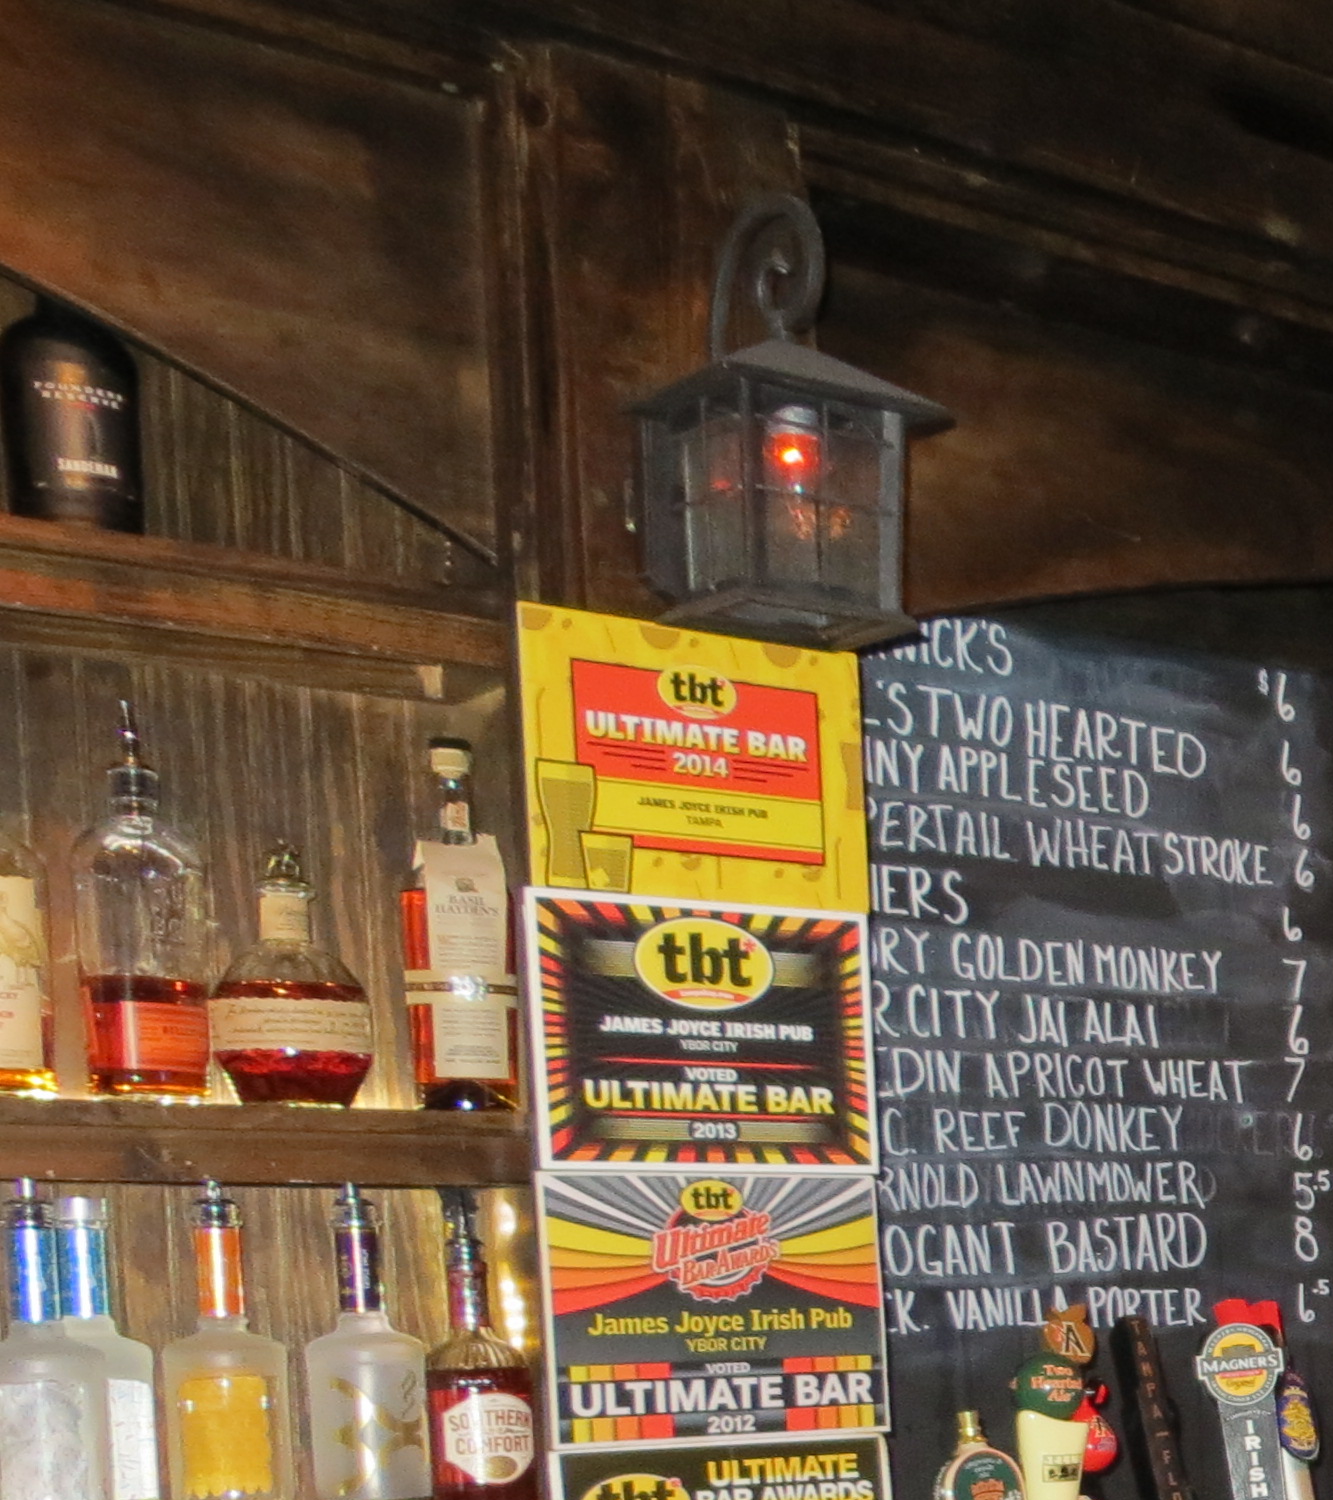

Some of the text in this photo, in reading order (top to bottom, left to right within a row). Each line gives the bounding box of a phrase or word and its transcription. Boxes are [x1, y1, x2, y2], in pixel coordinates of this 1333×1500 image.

[671, 672, 725, 707] tbt
[585, 710, 807, 762] ULTIMATE BAR
[917, 685, 1013, 747] TWO
[1025, 700, 1206, 778] HEARTED
[673, 752, 730, 778] 2014
[938, 743, 1149, 818] APPLESEED
[638, 797, 675, 810] JAMES
[678, 800, 713, 814] JOYCE
[748, 807, 768, 819] PUB
[1025, 817, 1158, 875] WHEAT
[1162, 832, 1274, 885] STROKE
[657, 933, 752, 987] tbt
[951, 931, 1222, 993] GOLDEN MONKEY
[600, 1016, 813, 1042] JAMES JOYCE IRISH PUB
[681, 1039, 738, 1053] YBOR CITY
[684, 1067, 738, 1082] VOTED
[986, 1051, 1256, 1103] APRICOT WHEAT
[583, 1079, 835, 1115] ULTIMATE BAR
[693, 1123, 737, 1139] 2013
[933, 1102, 1183, 1153] REEF DONKEY
[691, 1187, 733, 1210] tbt
[999, 1162, 1206, 1209] LAWNMOWER
[654, 1213, 770, 1270] Ultimate
[1047, 1212, 1206, 1274] BASTARD
[587, 1308, 852, 1337] James Joyce Irish Pub
[686, 1336, 767, 1353] YBOR CITY
[706, 1362, 750, 1375] VOTED
[1201, 1353, 1279, 1374] MAGNERS
[569, 1372, 874, 1417] ULTIMATE BAR
[448, 1409, 530, 1433] SOTHERN
[707, 1415, 756, 1434] 2012
[707, 1453, 859, 1486] ULTIMATE
[1243, 1419, 1269, 1498] IRISH
